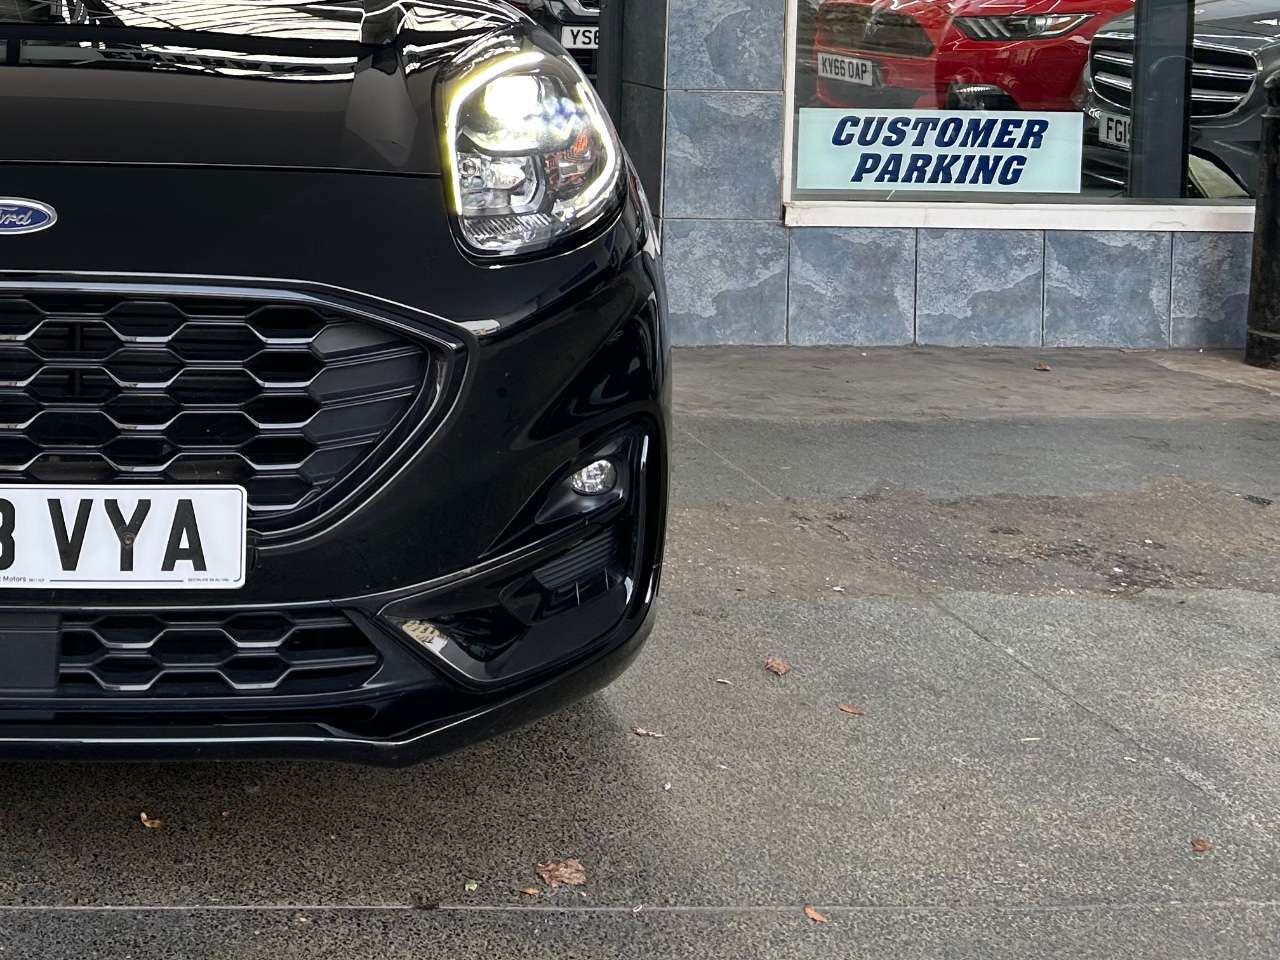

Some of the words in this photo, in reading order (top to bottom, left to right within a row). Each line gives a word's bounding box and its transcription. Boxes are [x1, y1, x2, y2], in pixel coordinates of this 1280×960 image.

[831, 115, 1049, 149] CUSTOMER
[850, 153, 1028, 185] PARKING
[47, 498, 208, 572] VYA
